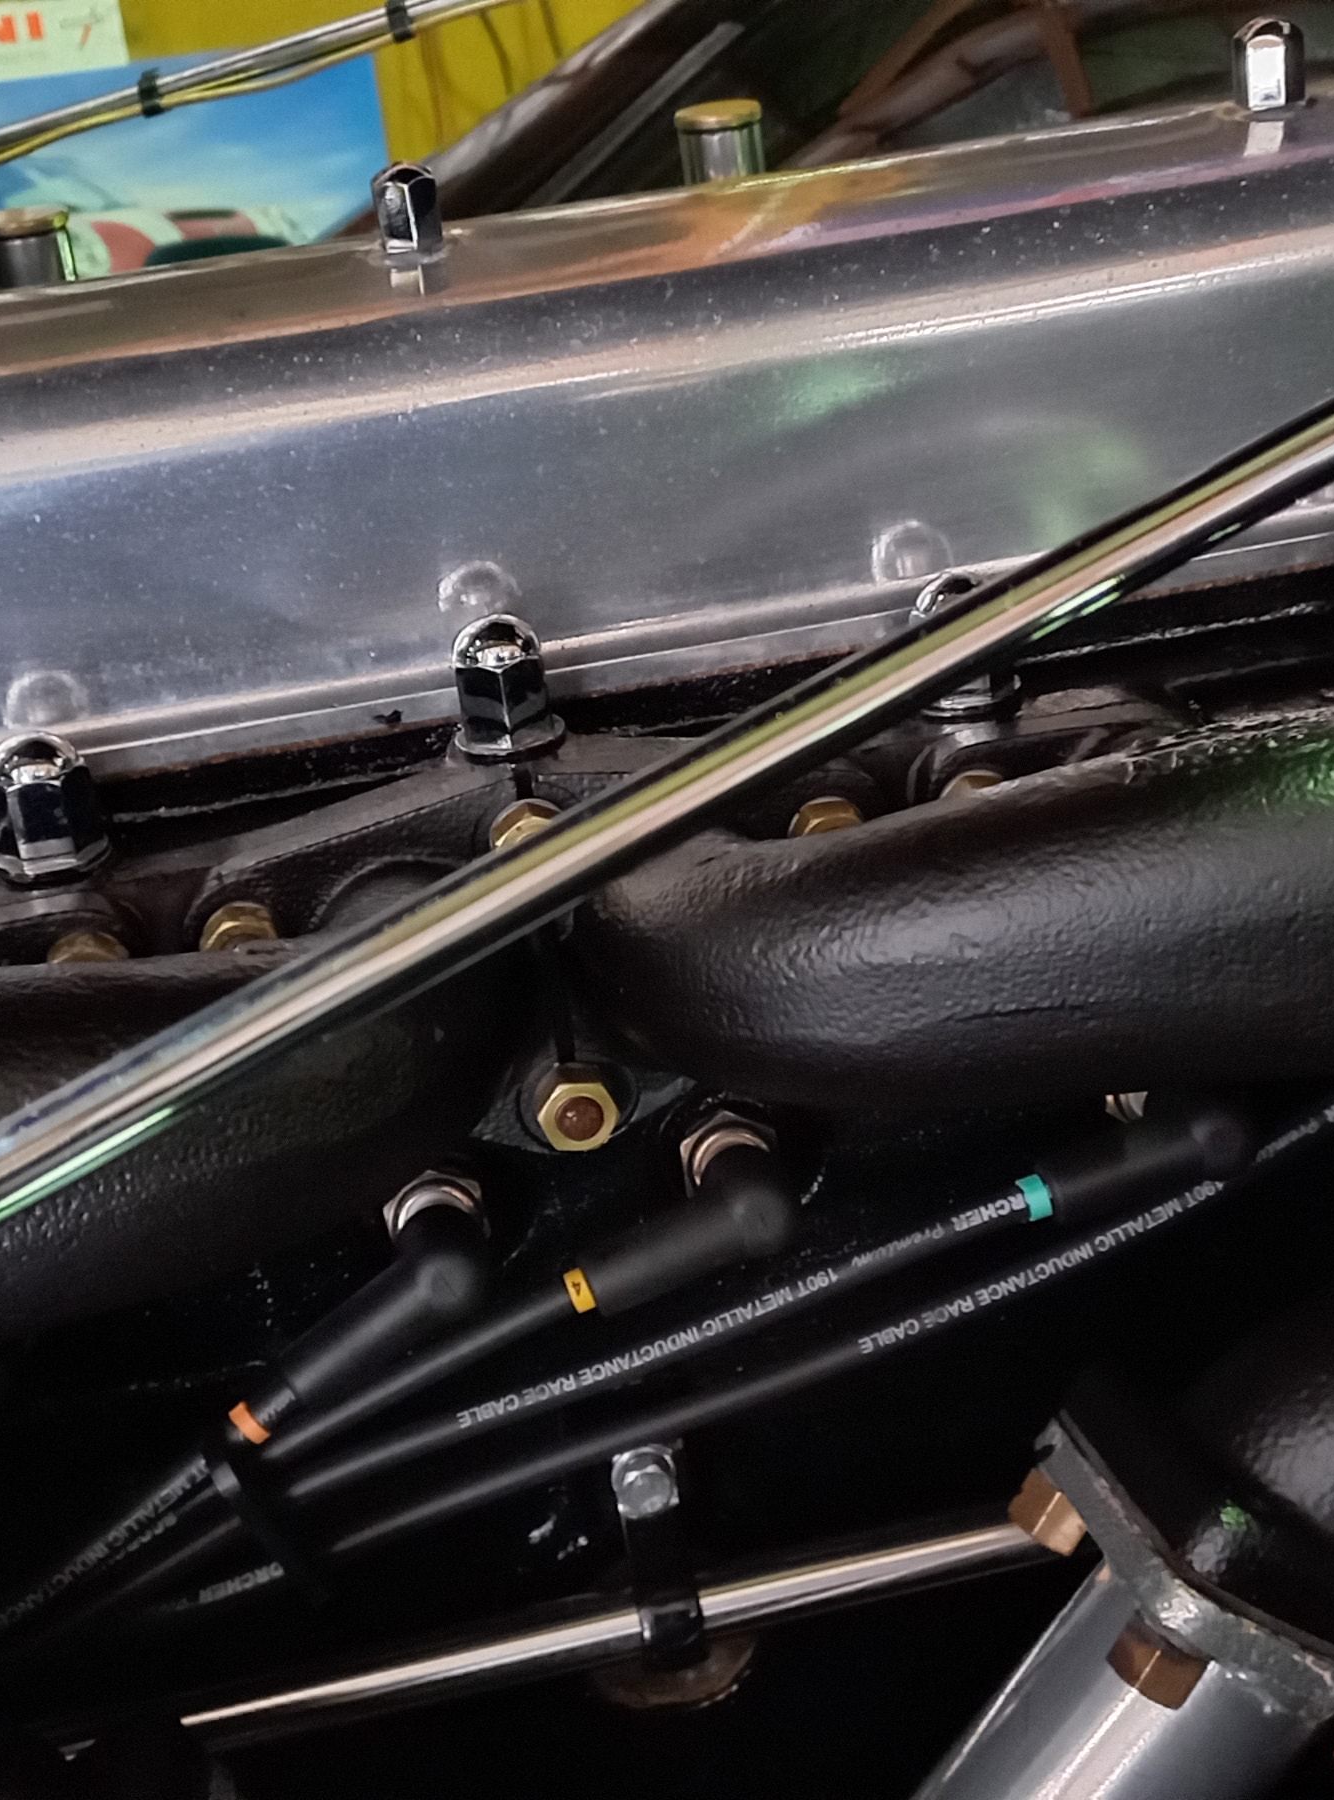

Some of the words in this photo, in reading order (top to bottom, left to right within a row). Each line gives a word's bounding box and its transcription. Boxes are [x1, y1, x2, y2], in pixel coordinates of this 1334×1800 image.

[1093, 1198, 1183, 1252] METALLIC
[850, 1223, 947, 1274] Premium
[571, 1281, 581, 1297] 4
[795, 1267, 839, 1299] 190T
[974, 1242, 1095, 1307] INDUCTANCE
[701, 1286, 795, 1337] METALLIC
[921, 1295, 976, 1329] RACE
[857, 1318, 921, 1354] CABLE
[577, 1326, 703, 1387] INDUCTANCE
[521, 1373, 579, 1407] RACE
[456, 1394, 523, 1430] CABLE
